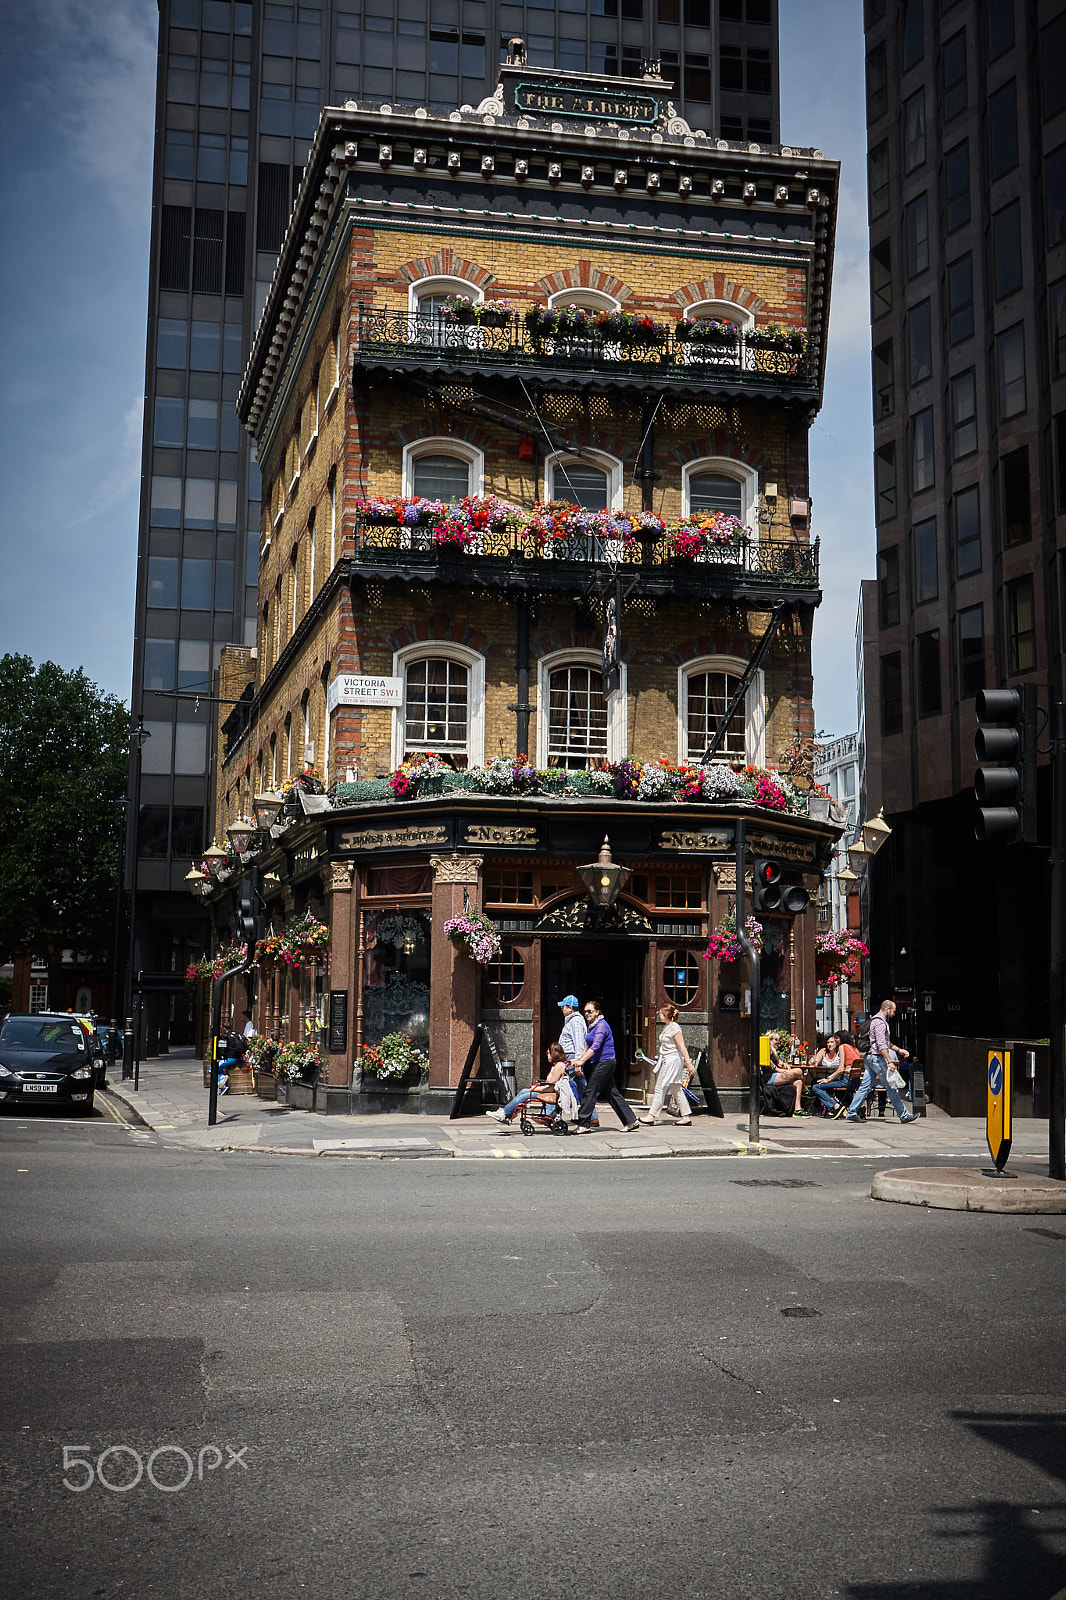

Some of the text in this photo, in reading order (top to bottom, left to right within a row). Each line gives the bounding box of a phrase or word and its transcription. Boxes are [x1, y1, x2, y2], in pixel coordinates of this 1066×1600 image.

[522, 92, 653, 118] THE ALBERT
[344, 678, 386, 688] VICTORIA
[343, 687, 398, 697] STREET SW1
